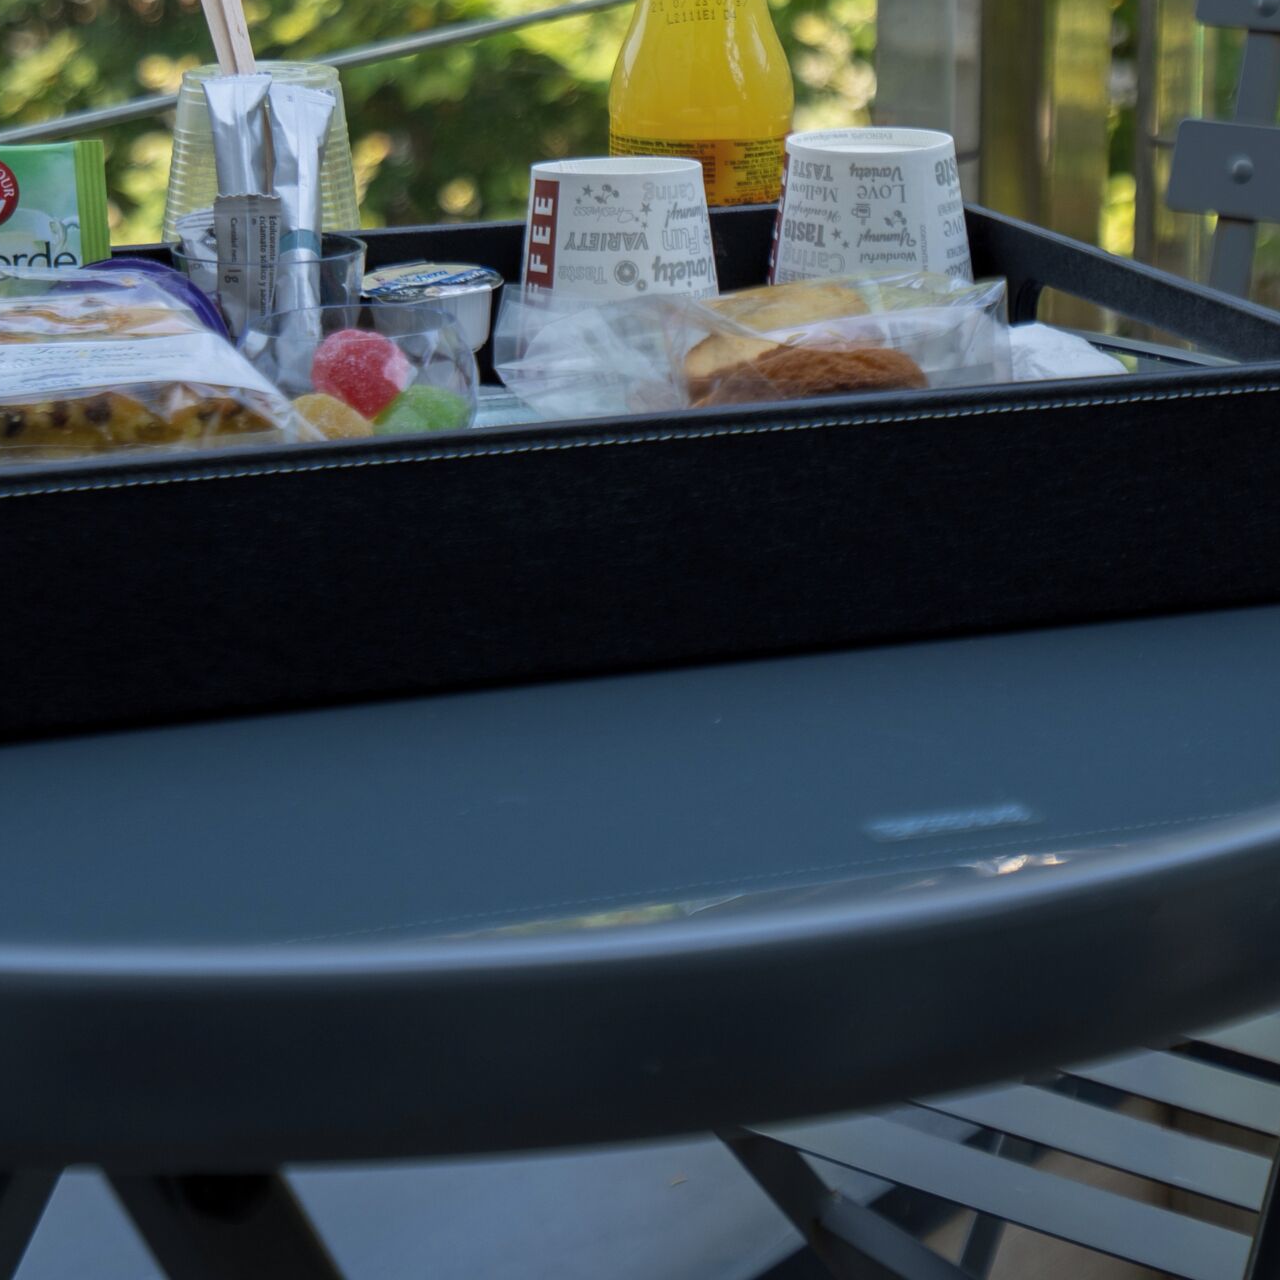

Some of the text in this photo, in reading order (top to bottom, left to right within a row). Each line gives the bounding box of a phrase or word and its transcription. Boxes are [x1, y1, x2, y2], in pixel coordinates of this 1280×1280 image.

[793, 159, 834, 182] TASTE
[850, 162, 904, 182] Variety
[934, 157, 958, 186] ste
[642, 182, 696, 201] Caring
[790, 183, 839, 203] Mellow
[857, 184, 907, 203] Love
[784, 218, 826, 248] Taste
[944, 216, 965, 237] ove
[564, 232, 649, 251] VARIETY
[662, 226, 701, 254] Fun
[857, 227, 917, 248] Yummy!
[783, 244, 846, 274] Caring
[860, 251, 917, 264] Wonderful
[558, 265, 608, 285] Taste
[652, 256, 717, 287] Variety
